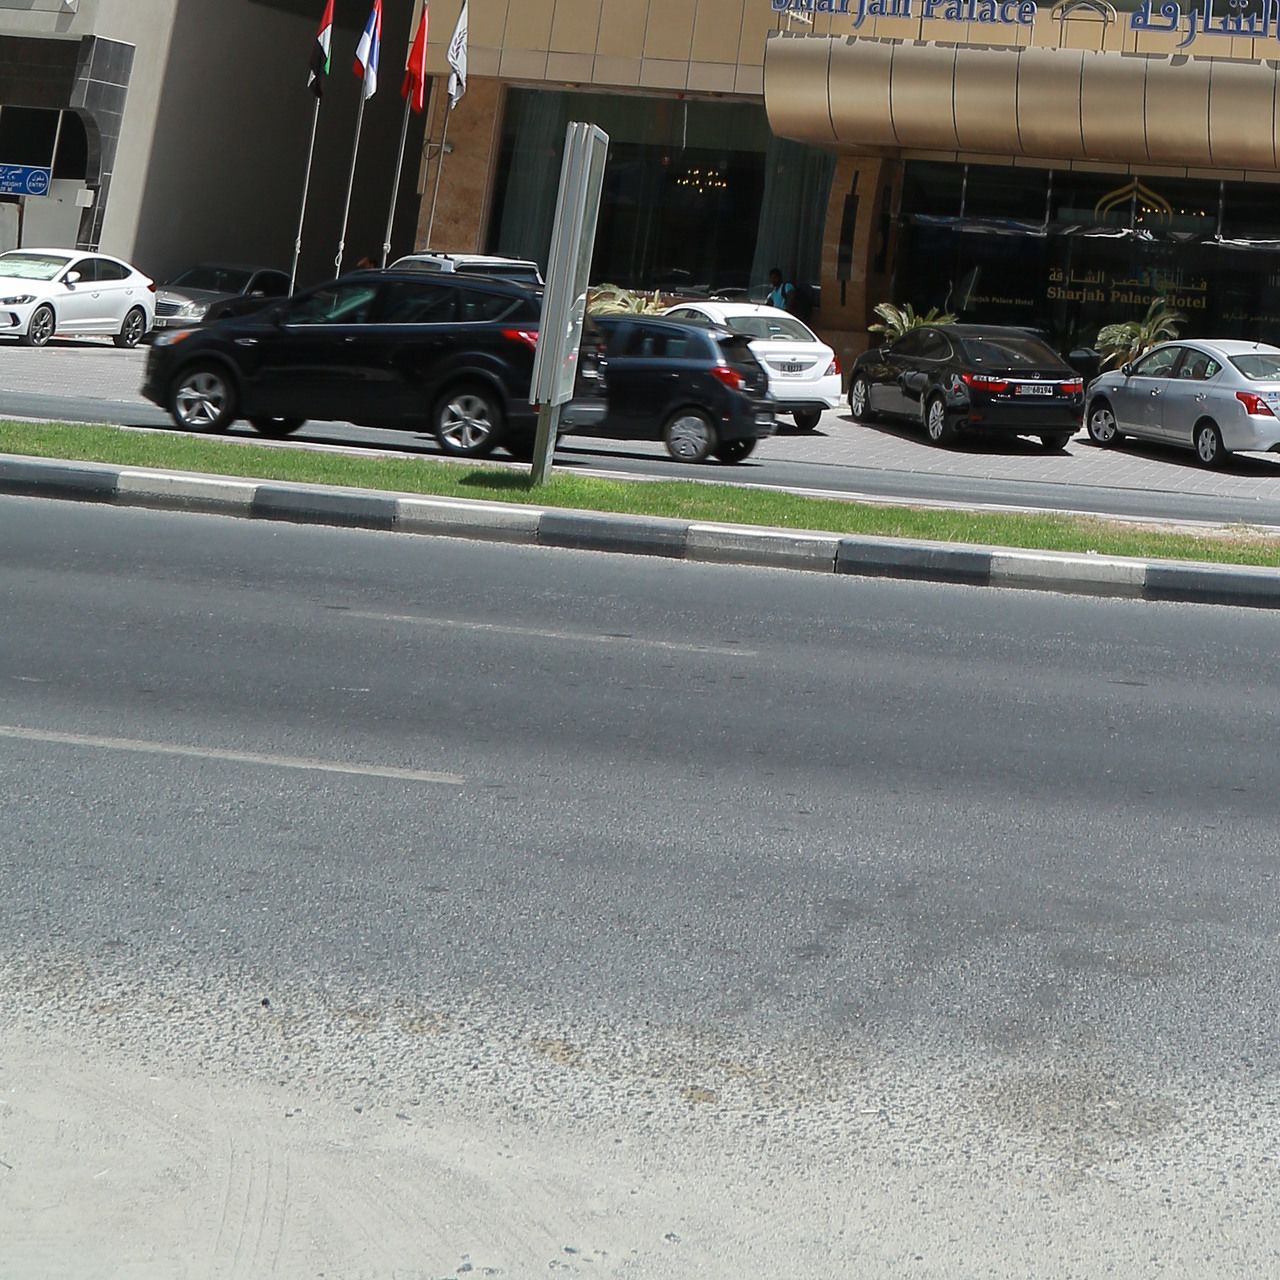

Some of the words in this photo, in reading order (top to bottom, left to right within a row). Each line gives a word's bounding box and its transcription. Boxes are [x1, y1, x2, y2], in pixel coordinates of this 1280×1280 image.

[1046, 286, 1105, 304] Sharjah
[1111, 291, 1158, 304] Palac
[1166, 294, 1207, 308] Hotel
